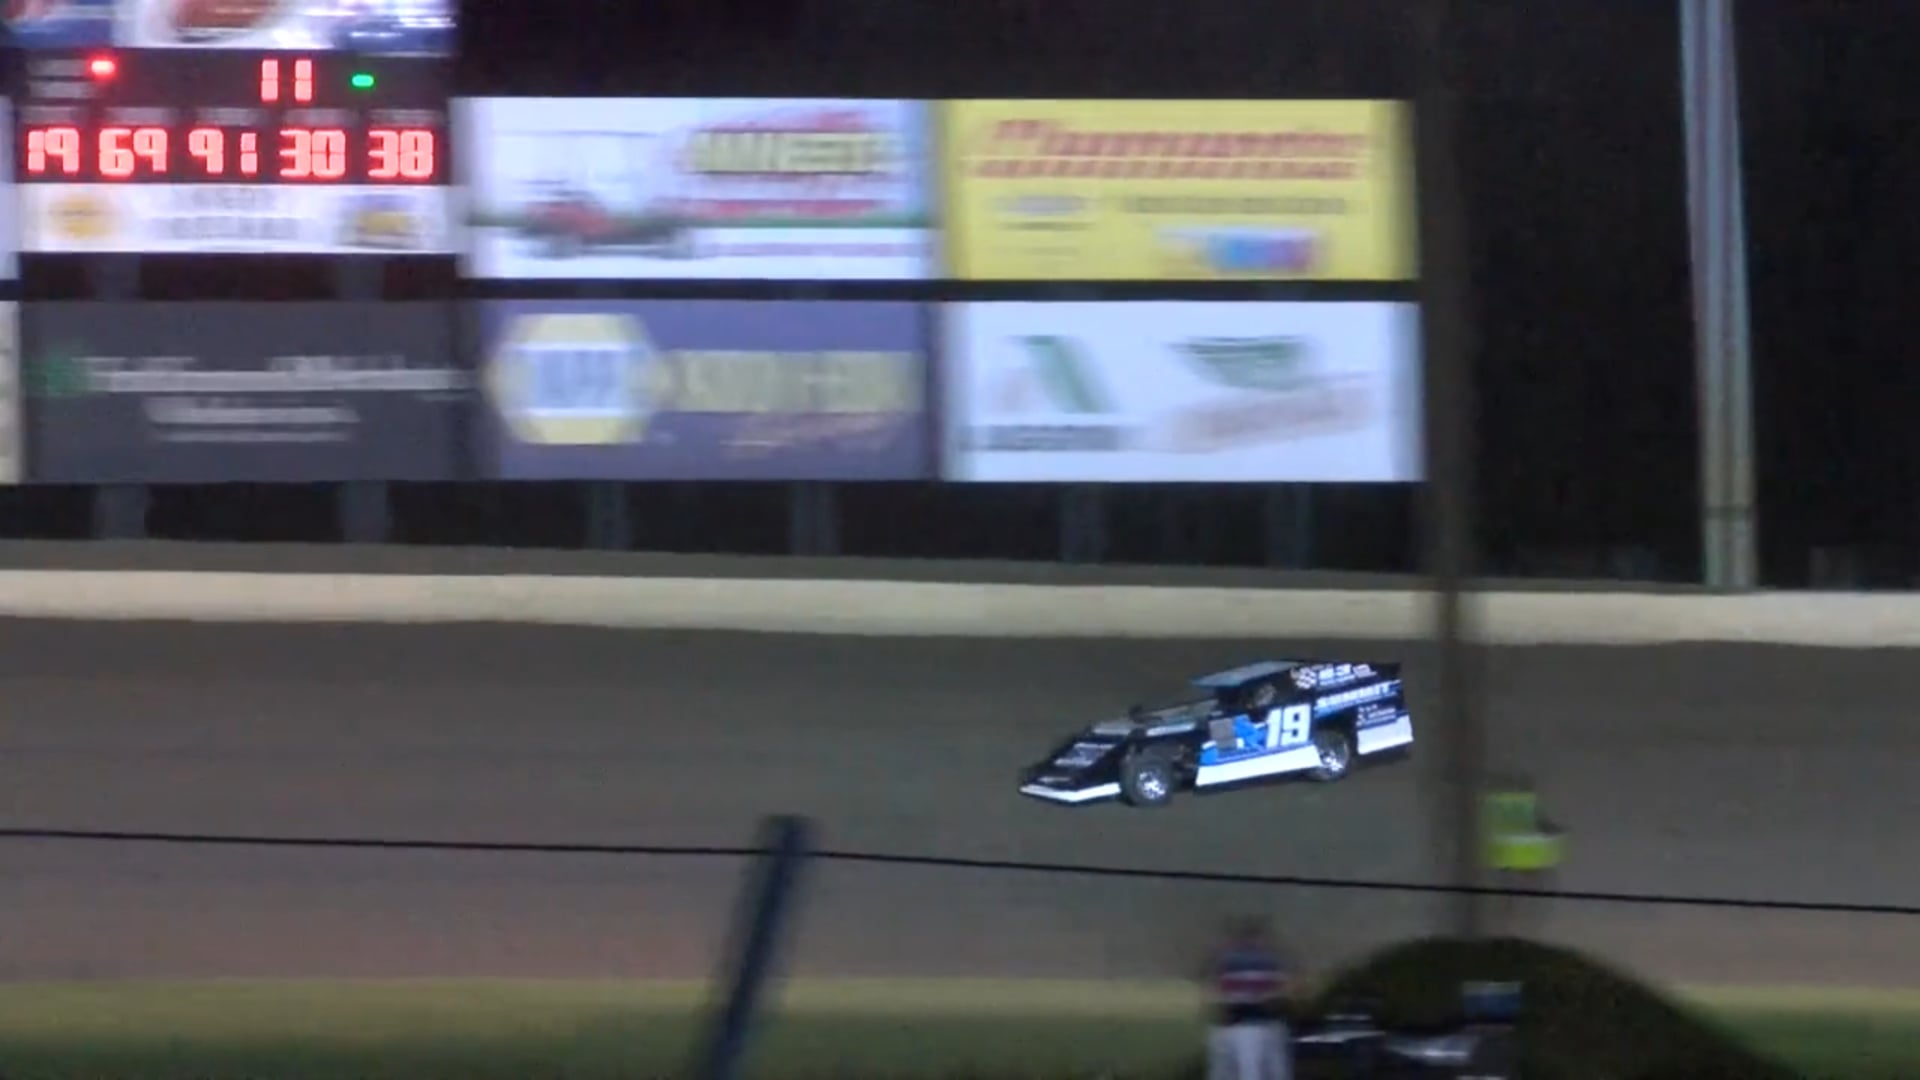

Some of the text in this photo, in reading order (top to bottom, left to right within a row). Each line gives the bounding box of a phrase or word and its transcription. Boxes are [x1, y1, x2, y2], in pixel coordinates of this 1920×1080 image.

[260, 59, 313, 102] 11
[27, 127, 434, 178] 19 69 91 30 38
[1264, 703, 1312, 750] 19
